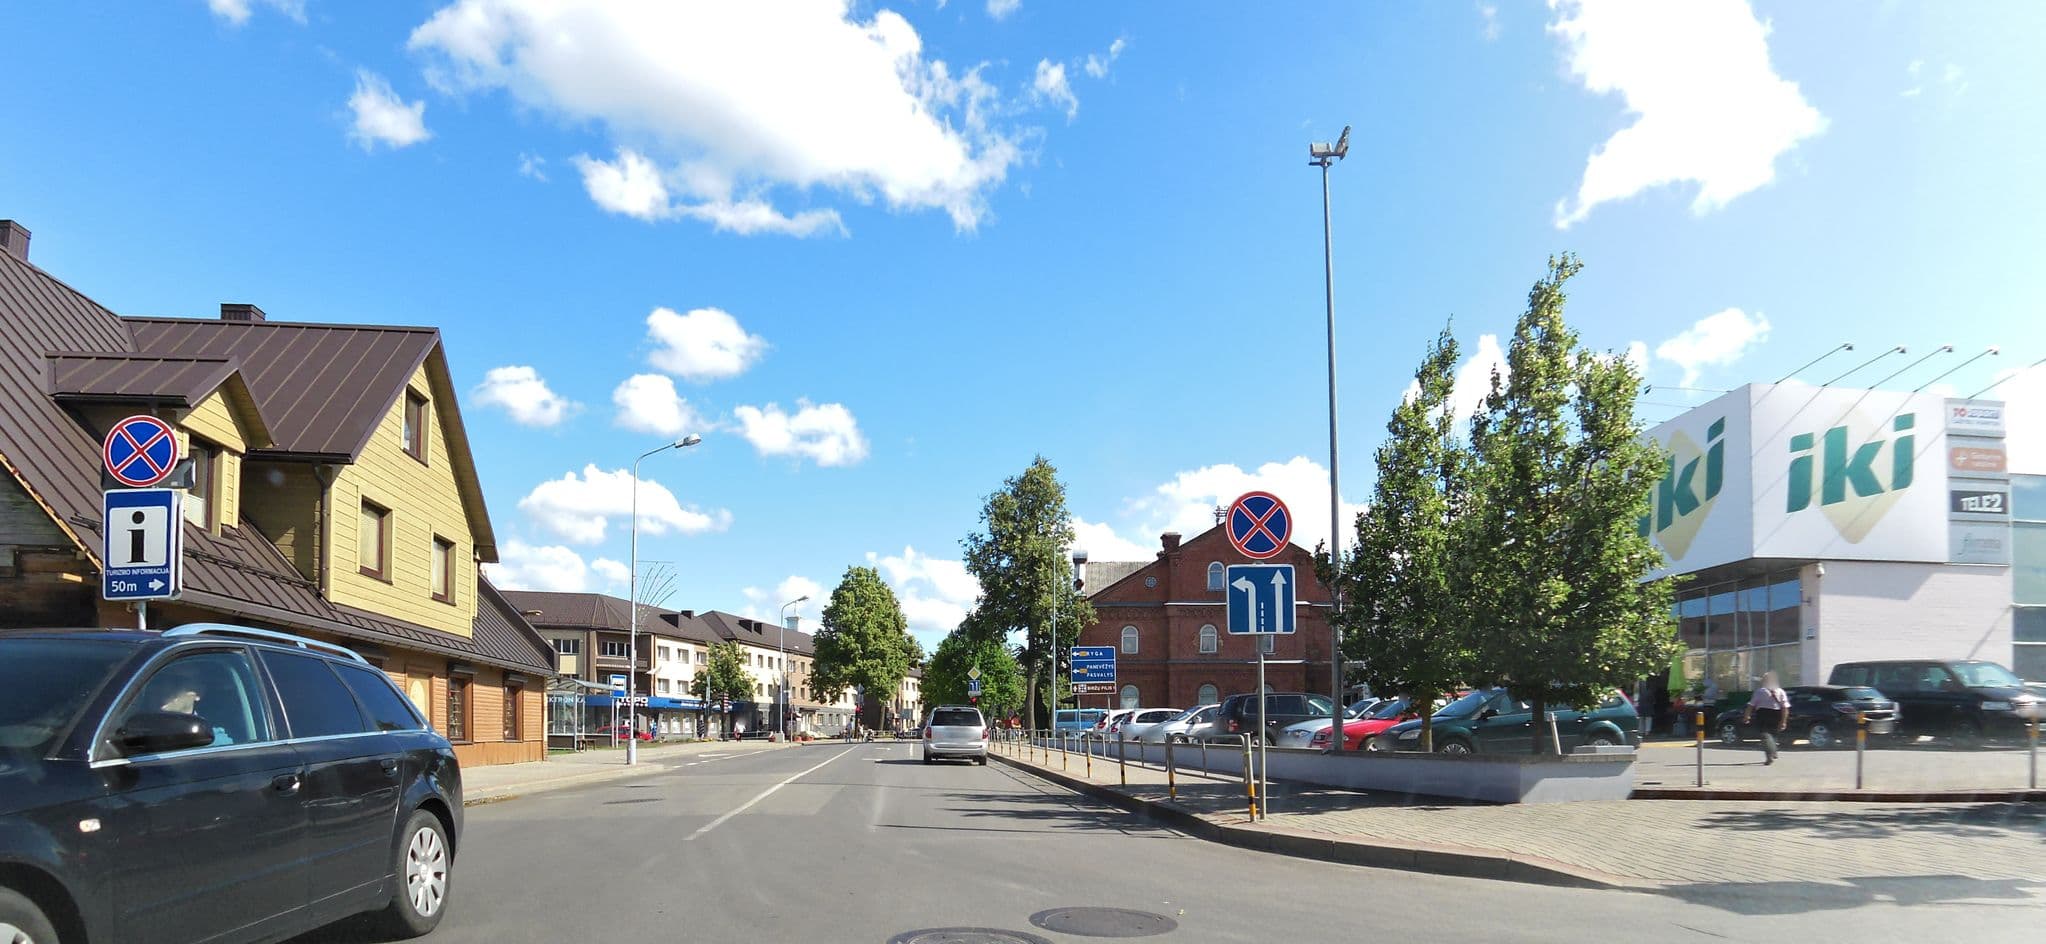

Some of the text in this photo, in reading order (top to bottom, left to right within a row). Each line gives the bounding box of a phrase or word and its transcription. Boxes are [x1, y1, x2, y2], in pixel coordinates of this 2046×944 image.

[1786, 412, 1915, 513] iki
[1961, 494, 2003, 512] TELE2
[131, 567, 169, 575] INFORMACIJA
[112, 580, 137, 592] 50m
